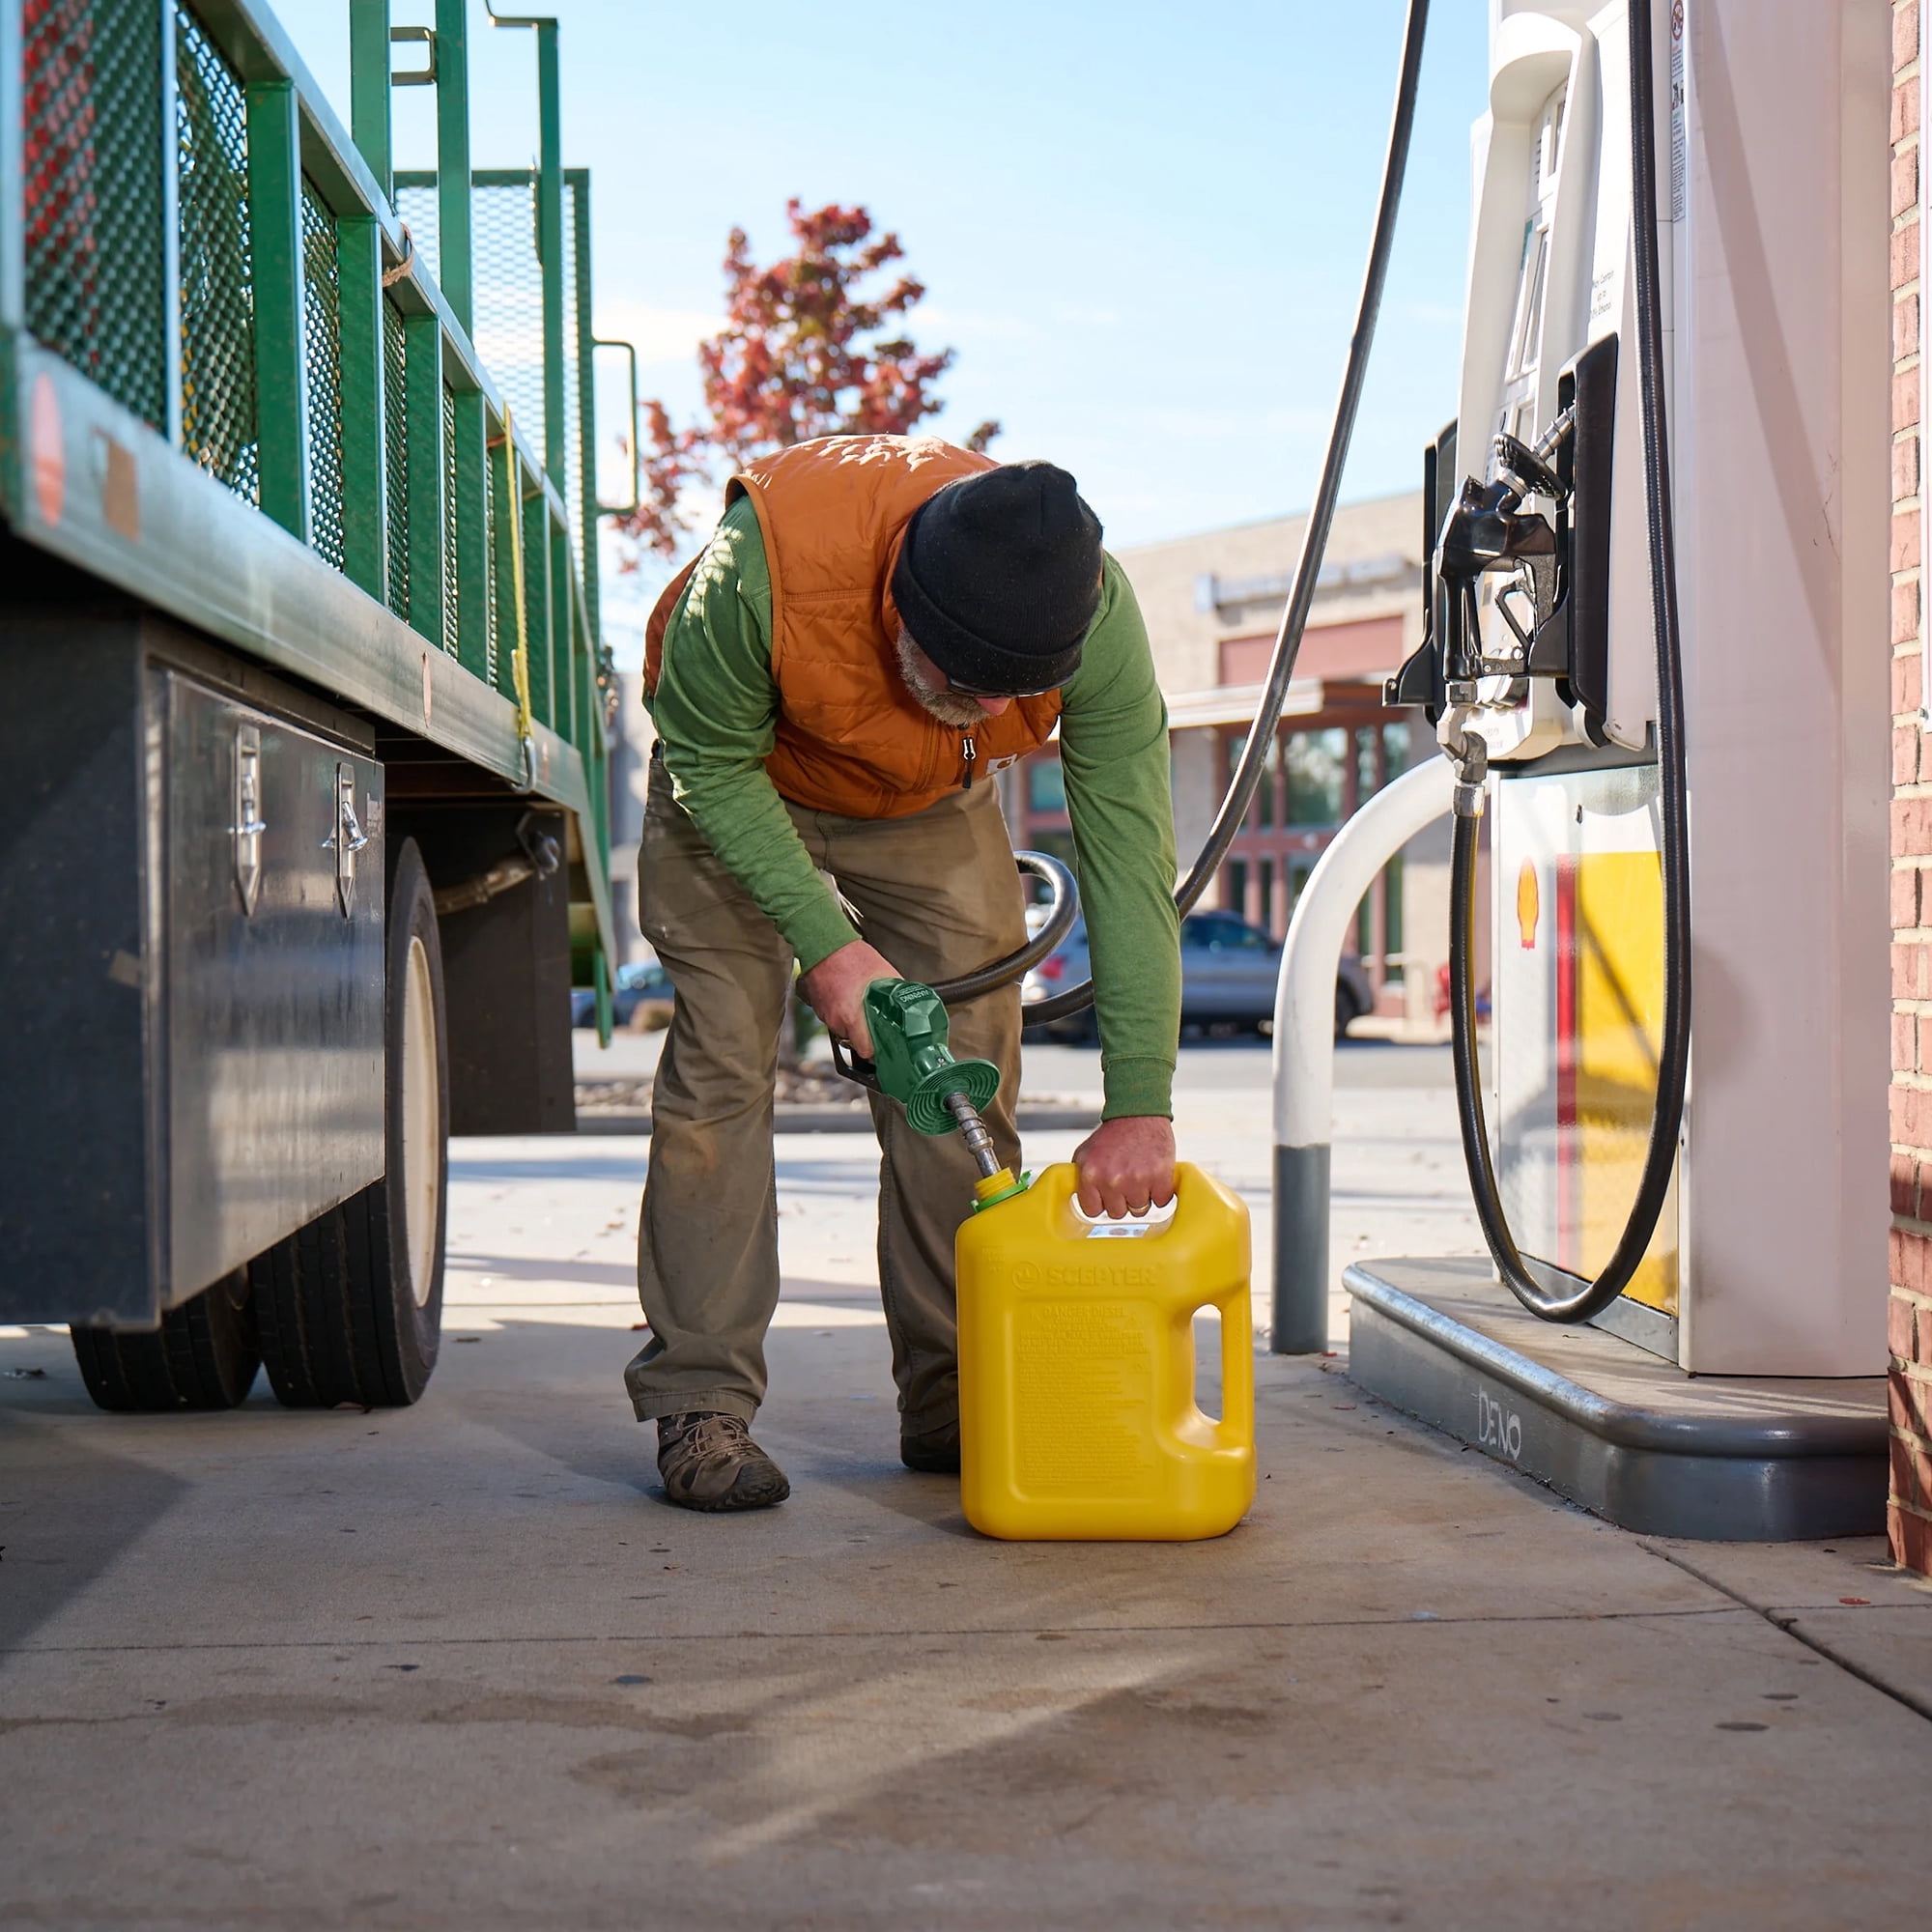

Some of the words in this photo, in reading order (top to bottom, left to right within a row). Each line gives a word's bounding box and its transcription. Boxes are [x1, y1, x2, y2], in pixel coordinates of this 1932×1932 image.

[1047, 1266, 1156, 1287] SCEPTER
[1043, 1306, 1091, 1317] DANGER
[1094, 1306, 1128, 1317] DIESEL
